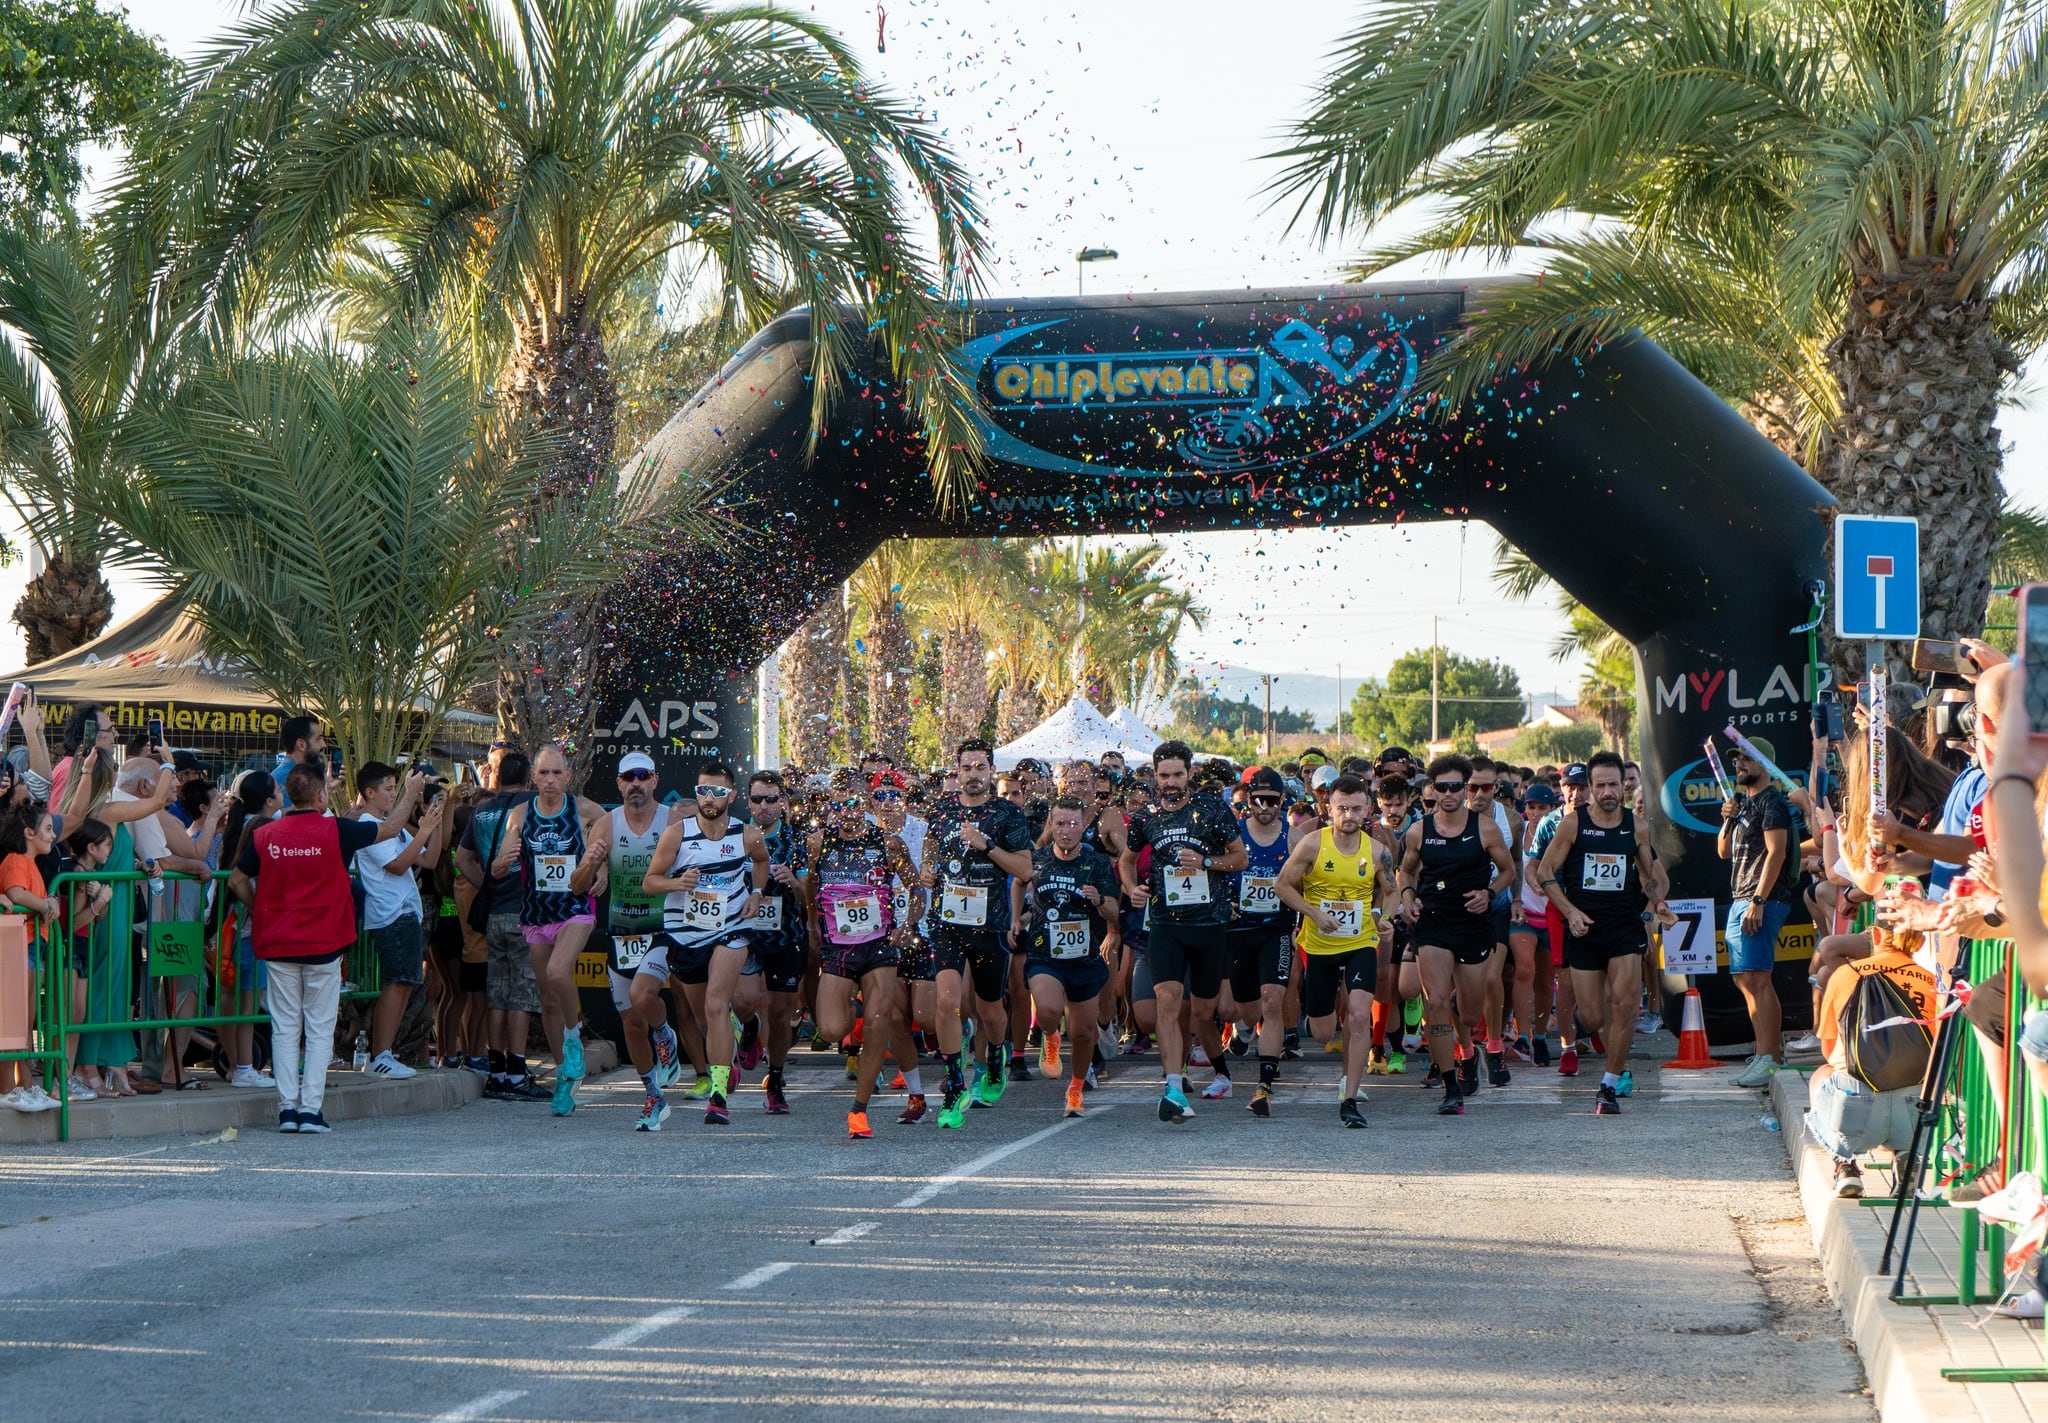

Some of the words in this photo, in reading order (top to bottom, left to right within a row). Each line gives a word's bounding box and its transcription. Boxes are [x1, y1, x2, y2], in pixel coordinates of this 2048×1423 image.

[995, 358, 1255, 404] Chiplevante
[989, 482, 1361, 513] www.chiplevante.com
[80, 650, 258, 674] MYLAP
[1656, 662, 1833, 716] MYLAP
[592, 698, 719, 739] LAPS
[1728, 710, 1798, 726] SPORTS
[596, 744, 652, 755] PORTS
[661, 745, 720, 757] TIMIN
[546, 865, 565, 879] 20
[1591, 863, 1620, 878] 120
[1181, 876, 1192, 891] 4
[1247, 886, 1276, 900] 206
[690, 899, 720, 916] 365
[960, 896, 968, 911] 1
[757, 905, 776, 919] 68
[847, 907, 869, 923] 98
[1056, 930, 1085, 946] 208
[1676, 912, 1702, 951] 7
[622, 940, 648, 955] 105
[1682, 954, 1697, 962] KM
